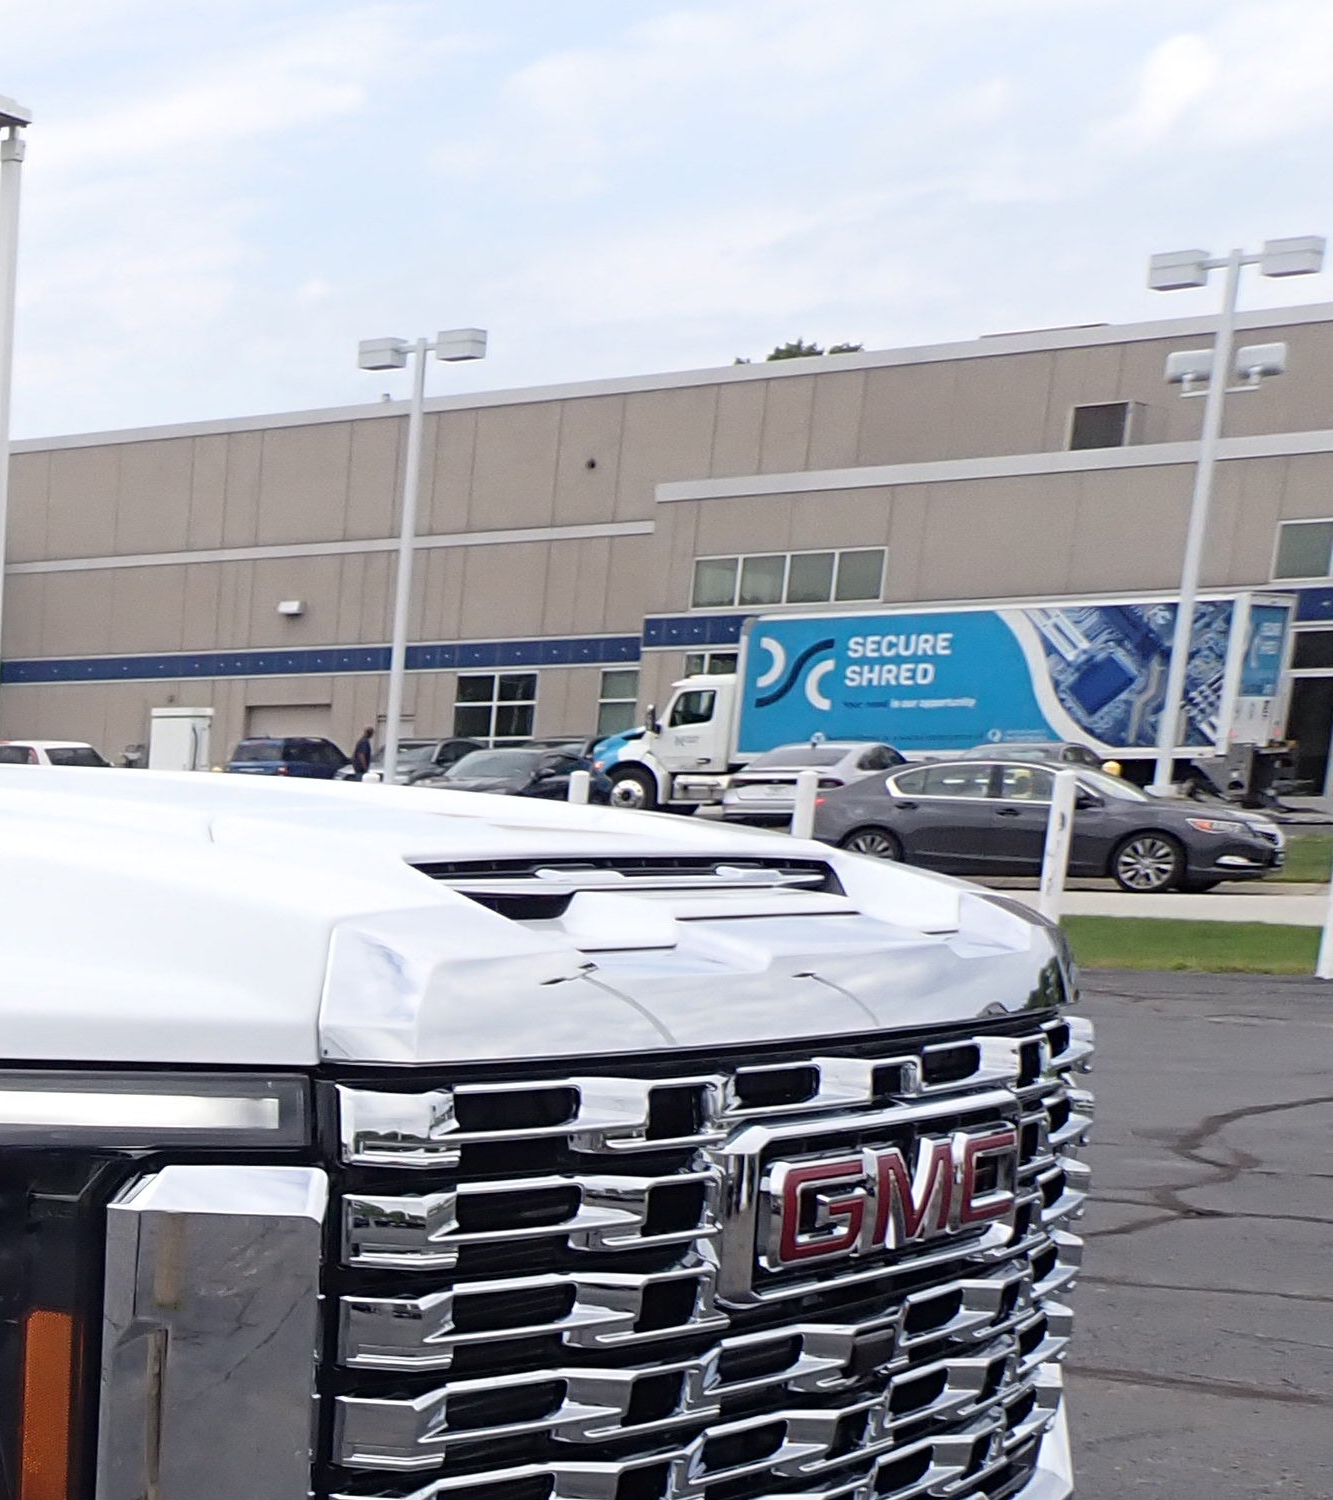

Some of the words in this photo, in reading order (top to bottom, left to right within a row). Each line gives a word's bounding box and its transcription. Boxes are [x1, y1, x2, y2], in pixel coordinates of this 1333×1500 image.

[846, 632, 954, 658] SECURE
[844, 662, 936, 687] SHRED
[761, 1121, 1018, 1272] GMC
